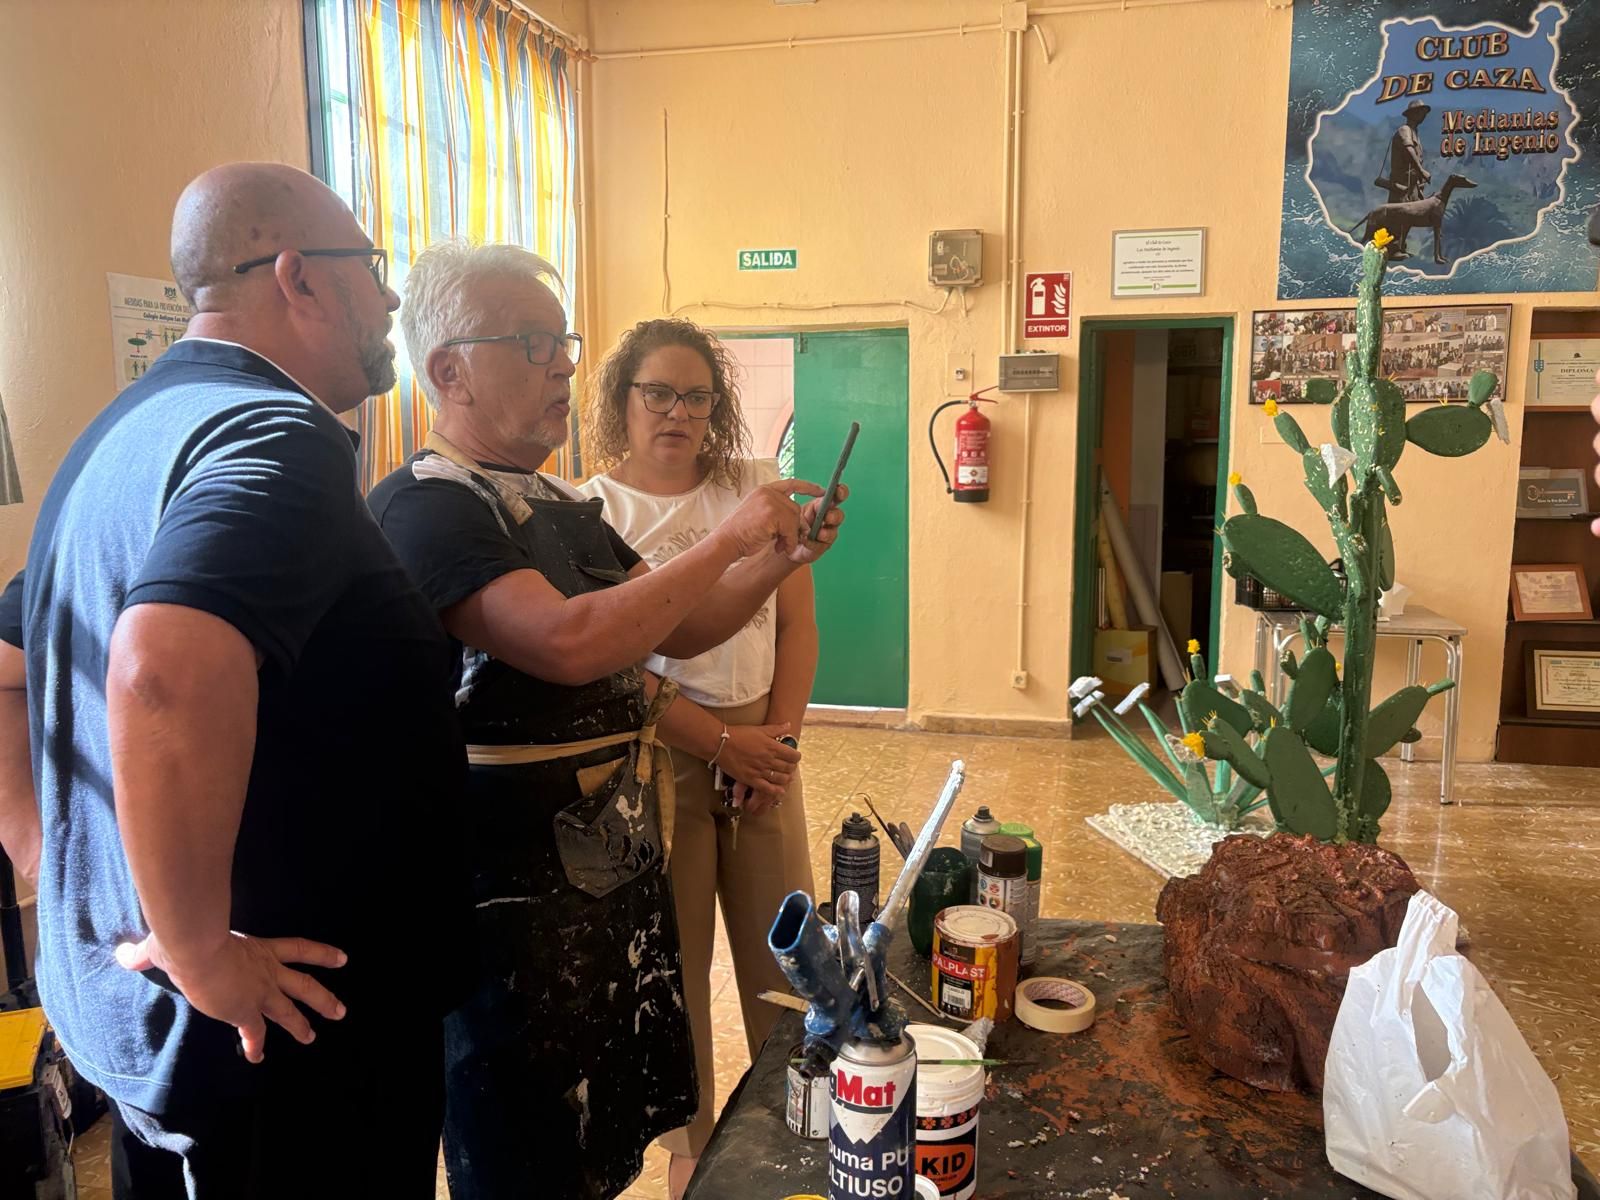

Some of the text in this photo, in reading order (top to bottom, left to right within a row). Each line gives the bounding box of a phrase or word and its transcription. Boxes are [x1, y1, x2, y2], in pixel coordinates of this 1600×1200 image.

[1416, 31, 1509, 61] CLUB
[1376, 67, 1546, 104] DE CAZA
[1441, 107, 1558, 134] Medianias
[1440, 128, 1559, 160] de Ingenio
[743, 252, 792, 266] SALIDA
[882, 1146, 909, 1171] PU
[829, 1163, 903, 1198] LTIUSO
